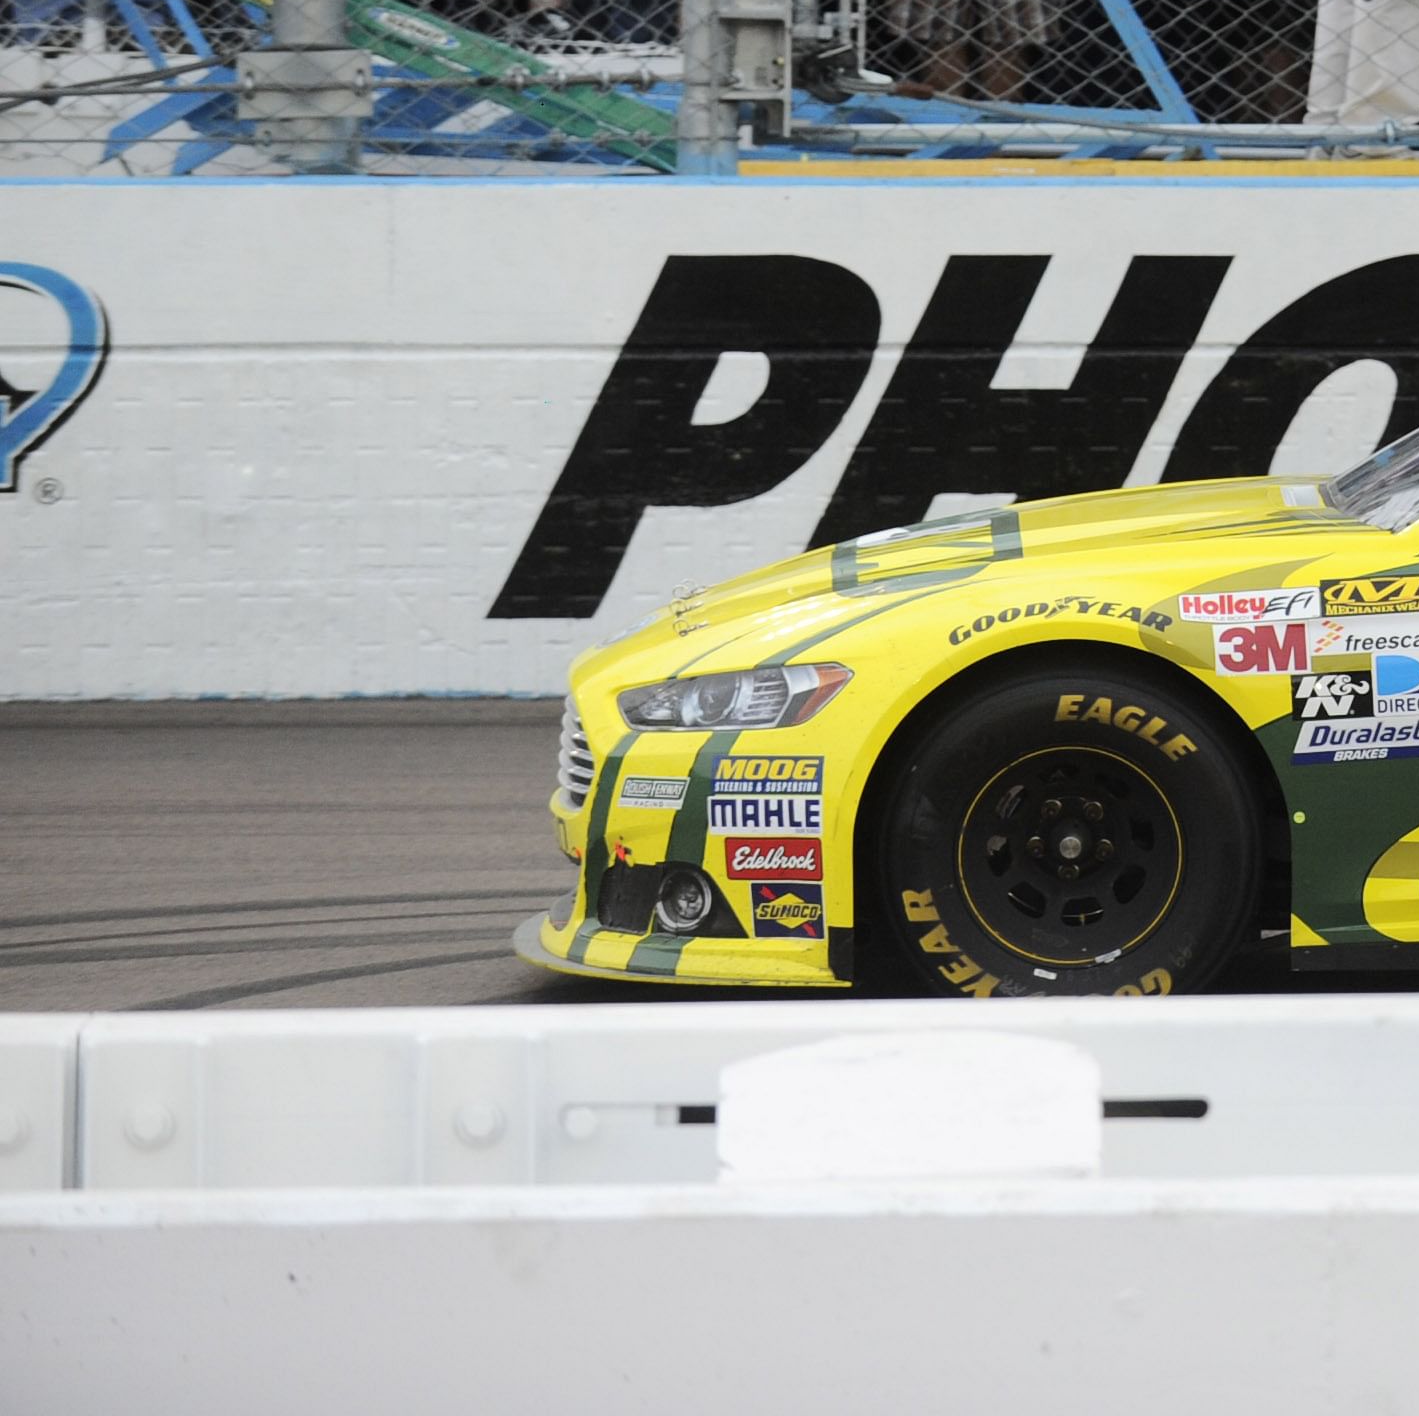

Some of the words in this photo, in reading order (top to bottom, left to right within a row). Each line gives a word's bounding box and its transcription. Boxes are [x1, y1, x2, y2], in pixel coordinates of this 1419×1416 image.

[1181, 594, 1266, 620] Holley
[1325, 602, 1396, 617] MECHANIX
[1218, 623, 1308, 673] 3M
[1053, 693, 1199, 761] EAGLE
[1333, 748, 1389, 762] BRAKES
[715, 758, 820, 781] MOOG
[710, 798, 821, 828] MAHLE
[731, 845, 817, 872] Edelbrock
[755, 903, 821, 920] SUNOCO
